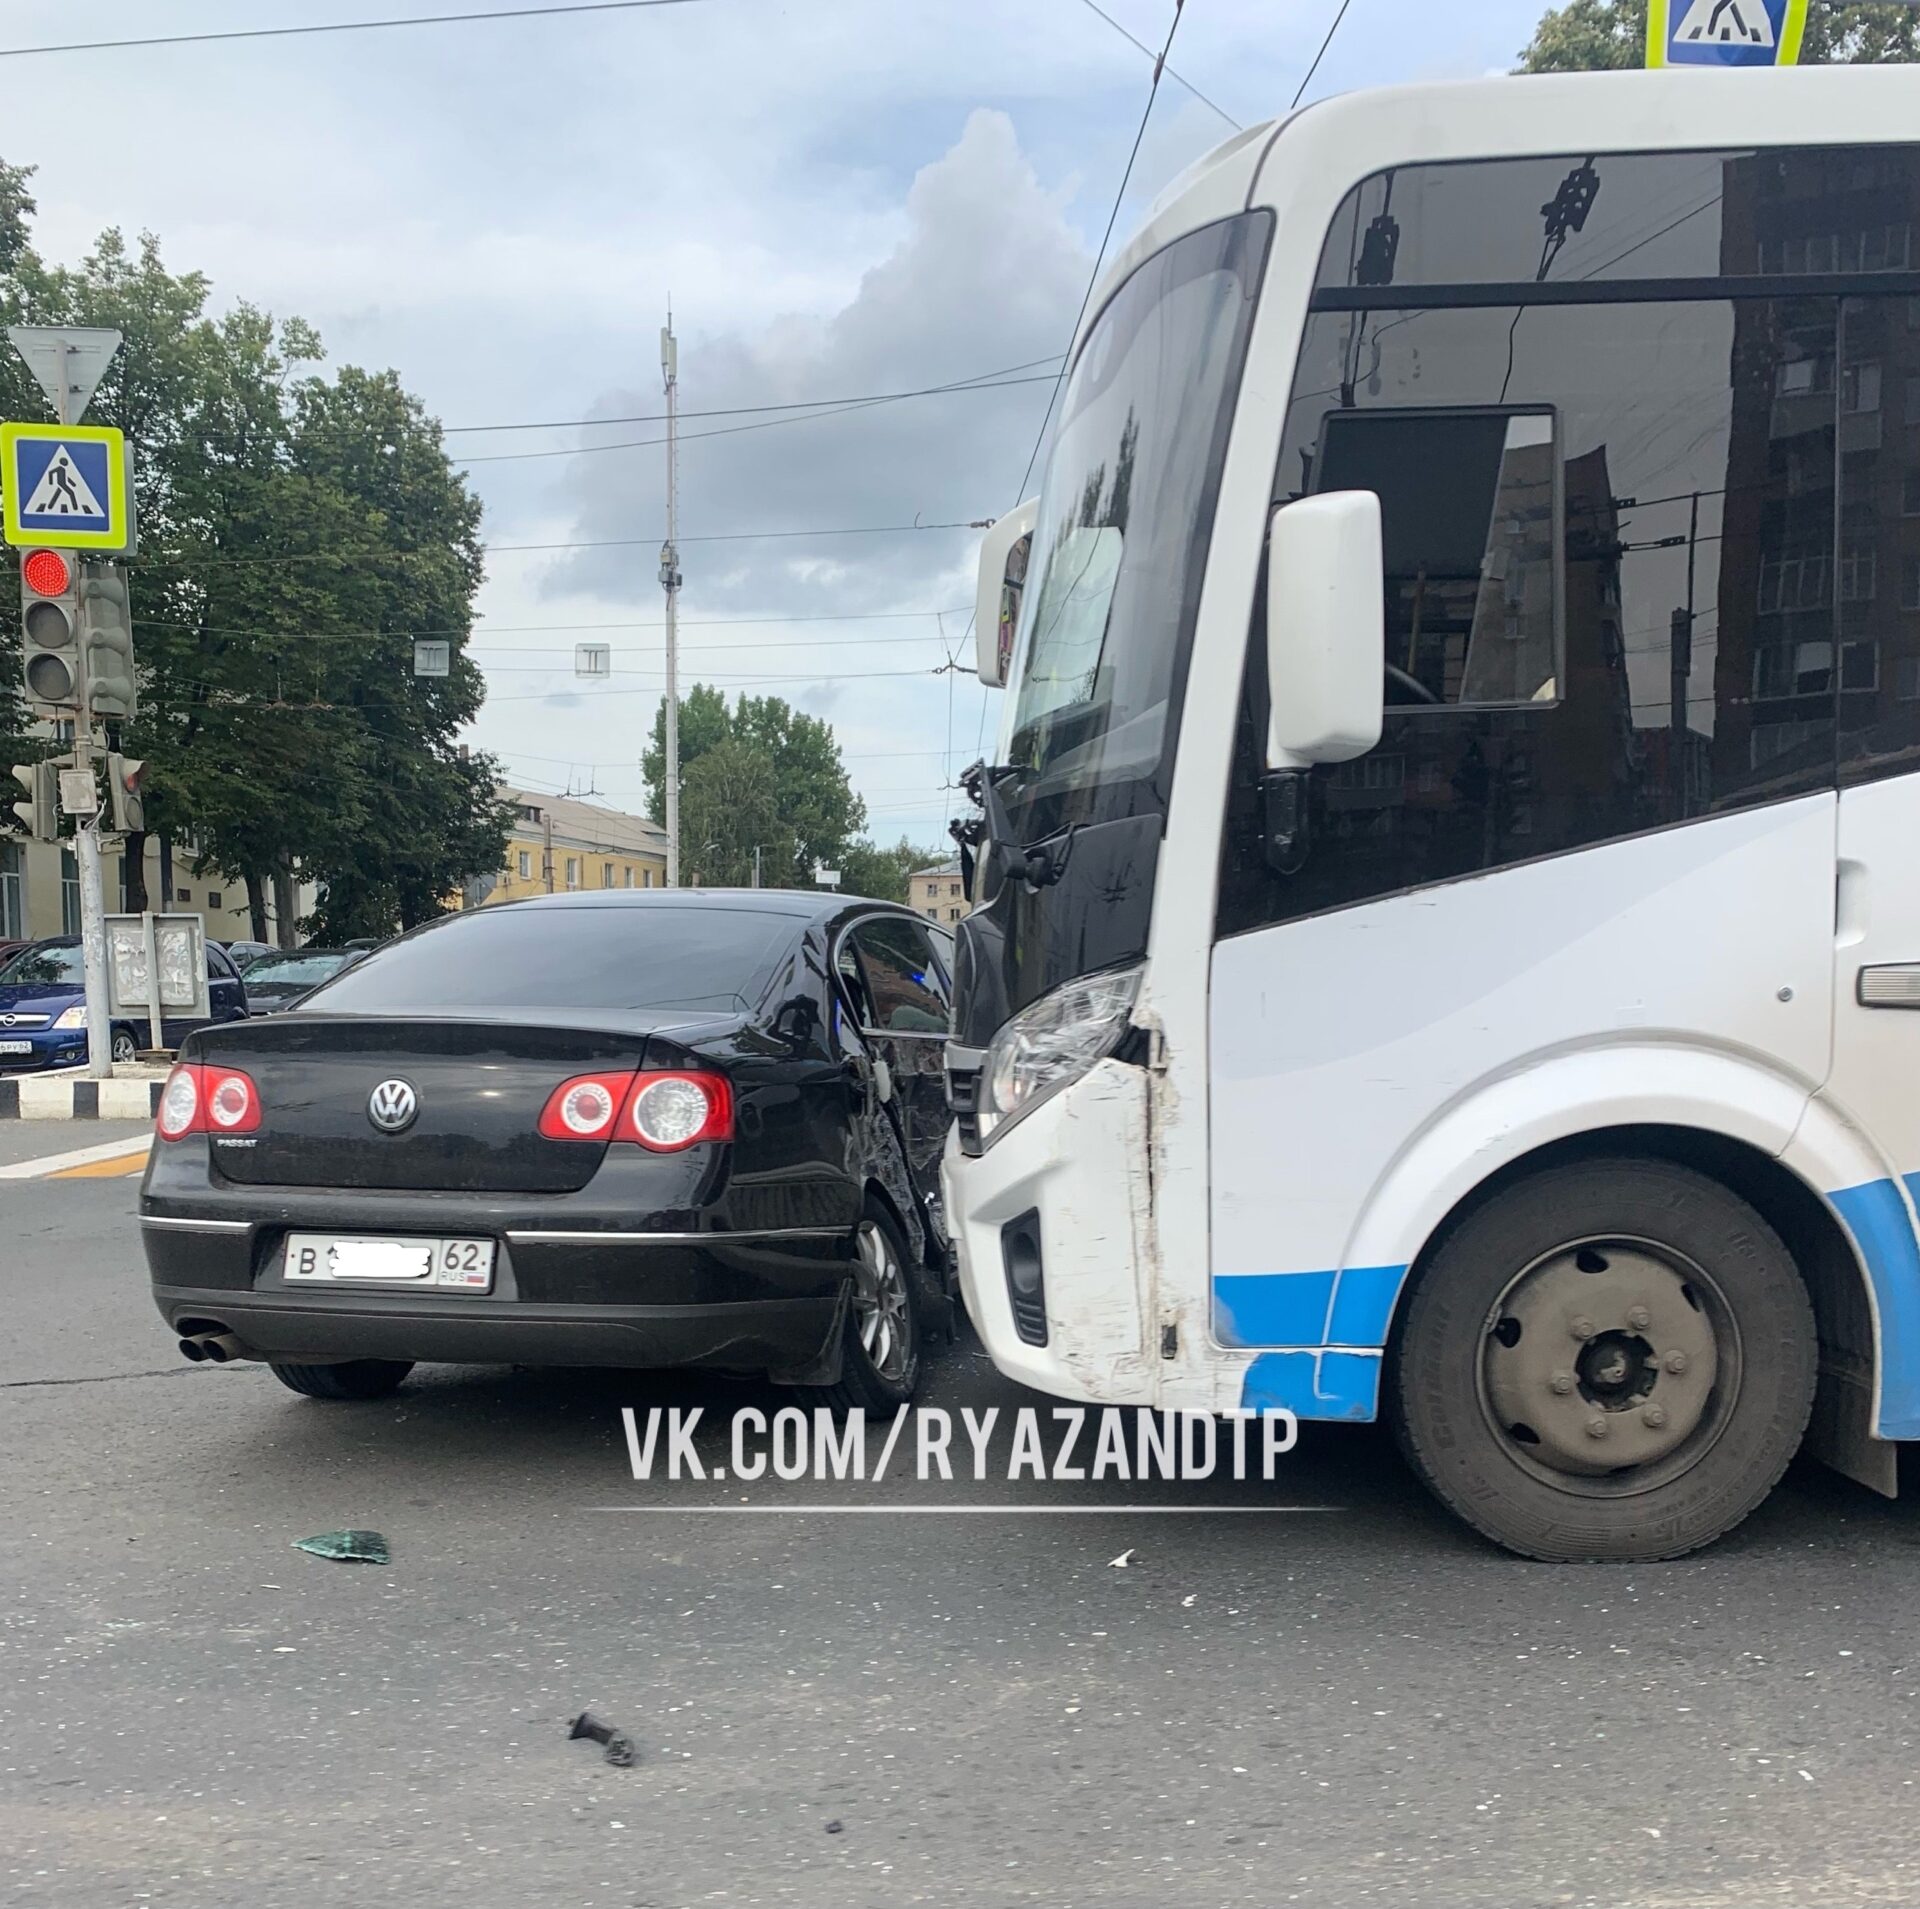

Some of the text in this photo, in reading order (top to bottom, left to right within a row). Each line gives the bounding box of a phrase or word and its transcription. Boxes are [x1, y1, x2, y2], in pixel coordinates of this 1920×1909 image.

[217, 1139, 258, 1148] PASSAT
[444, 1243, 479, 1271] 62
[441, 1272, 465, 1282] RUS
